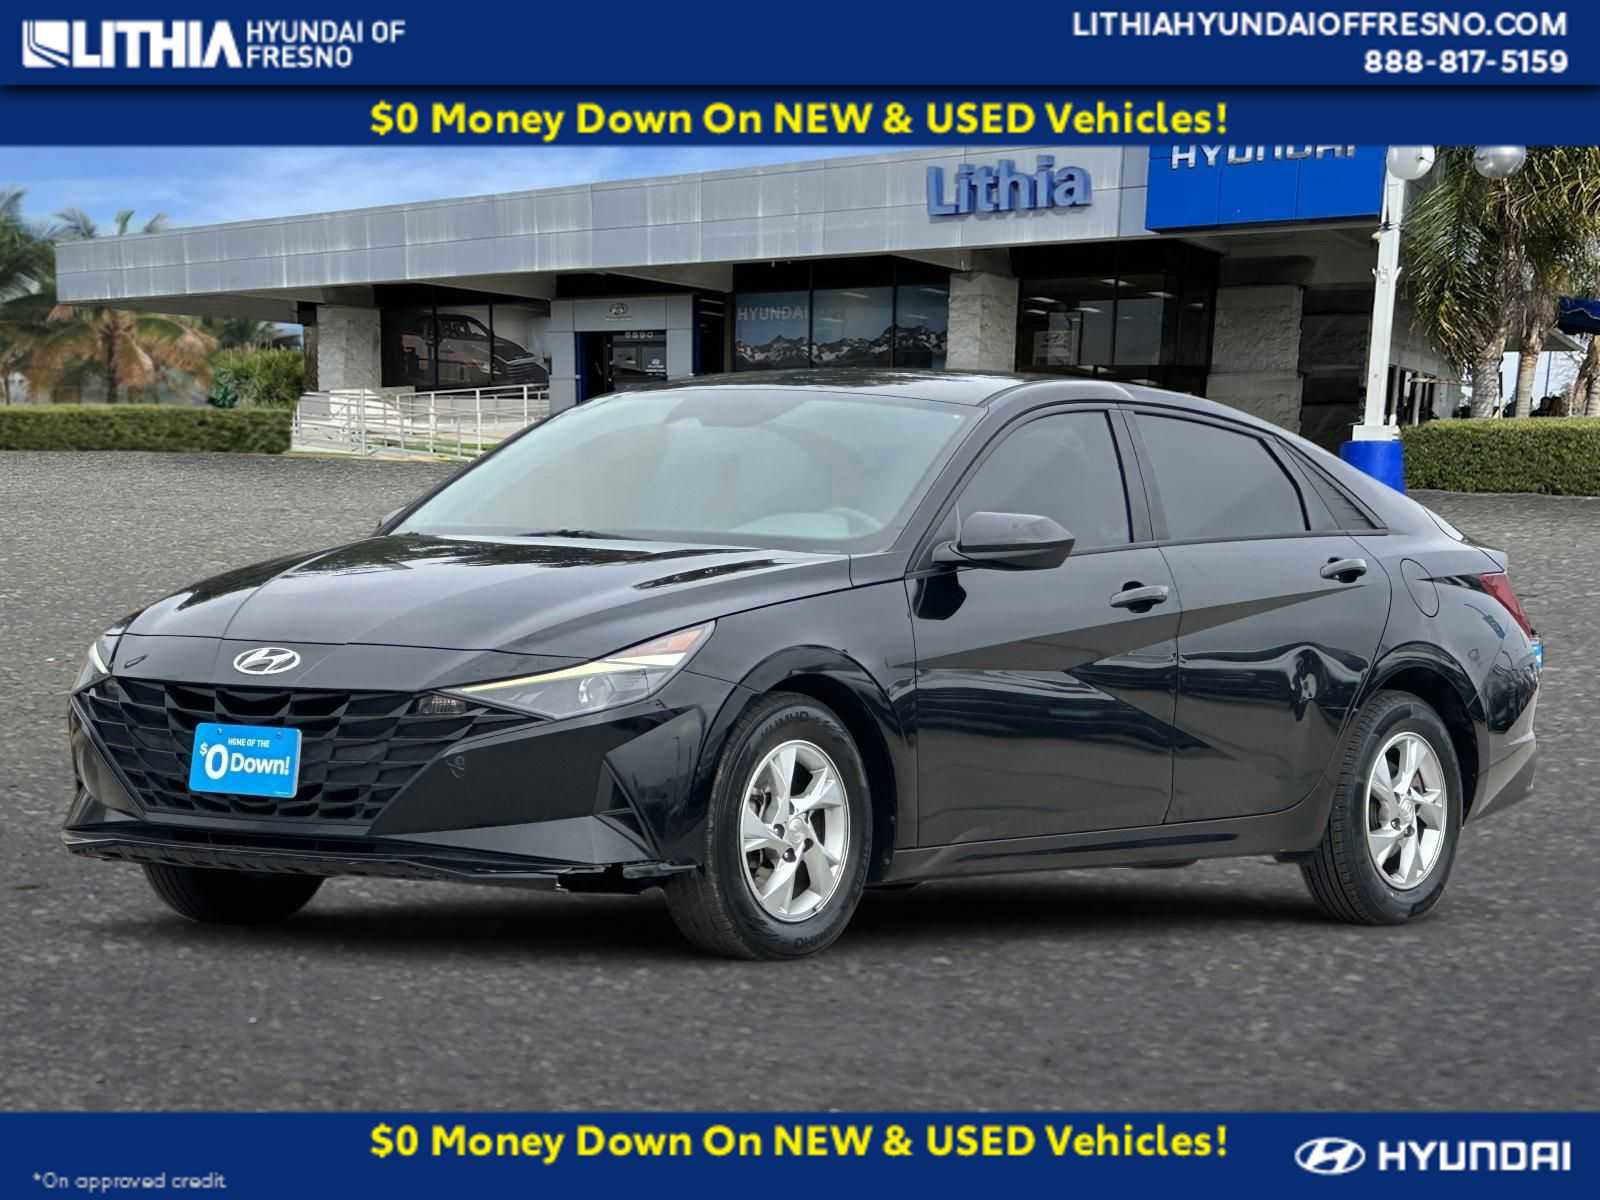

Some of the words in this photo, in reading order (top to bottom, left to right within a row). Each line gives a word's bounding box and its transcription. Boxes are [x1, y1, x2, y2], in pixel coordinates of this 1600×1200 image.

[926, 154, 1092, 216] Lithia
[737, 305, 809, 321] HYUNDAI
[199, 741, 229, 780] $0
[230, 752, 291, 776] Down!
